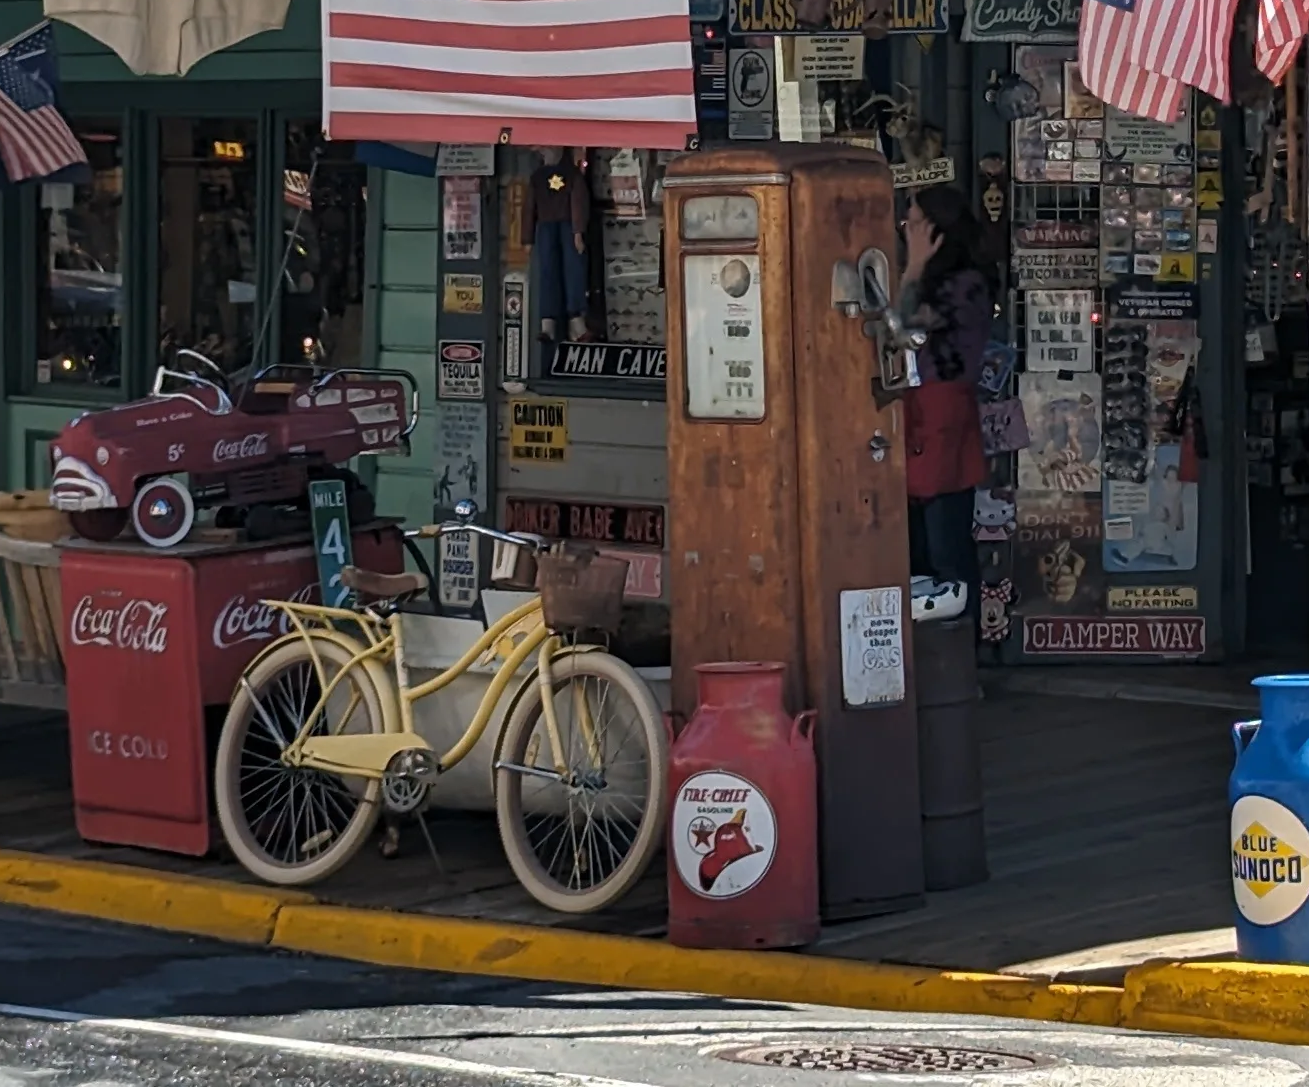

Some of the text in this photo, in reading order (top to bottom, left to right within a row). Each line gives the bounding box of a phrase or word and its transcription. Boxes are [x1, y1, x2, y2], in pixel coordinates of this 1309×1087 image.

[1019, 254, 1096, 267] POLITICALLY
[456, 290, 475, 301] YOU
[563, 344, 668, 378] MAN CAVE
[443, 363, 480, 379] TEQUILA
[514, 403, 564, 427] CAUTION
[314, 491, 345, 509] MILE
[569, 505, 616, 540] BABE
[321, 517, 346, 565] 4
[1018, 525, 1101, 543] DIAL 911
[447, 543, 470, 558] PANIC
[1124, 588, 1181, 598] PLEASE
[1111, 598, 1194, 608] NO FARTING
[863, 628, 899, 639] cheaper
[1032, 622, 1198, 649] CLAMPER WAY
[870, 639, 892, 648] than
[862, 646, 901, 670] GAS
[119, 734, 169, 760] COLD
[682, 787, 751, 803] FIRE-CHIEF
[697, 806, 734, 815] GASOLINE
[1241, 834, 1278, 853] BLUE
[1233, 849, 1302, 884] SUNOCO
